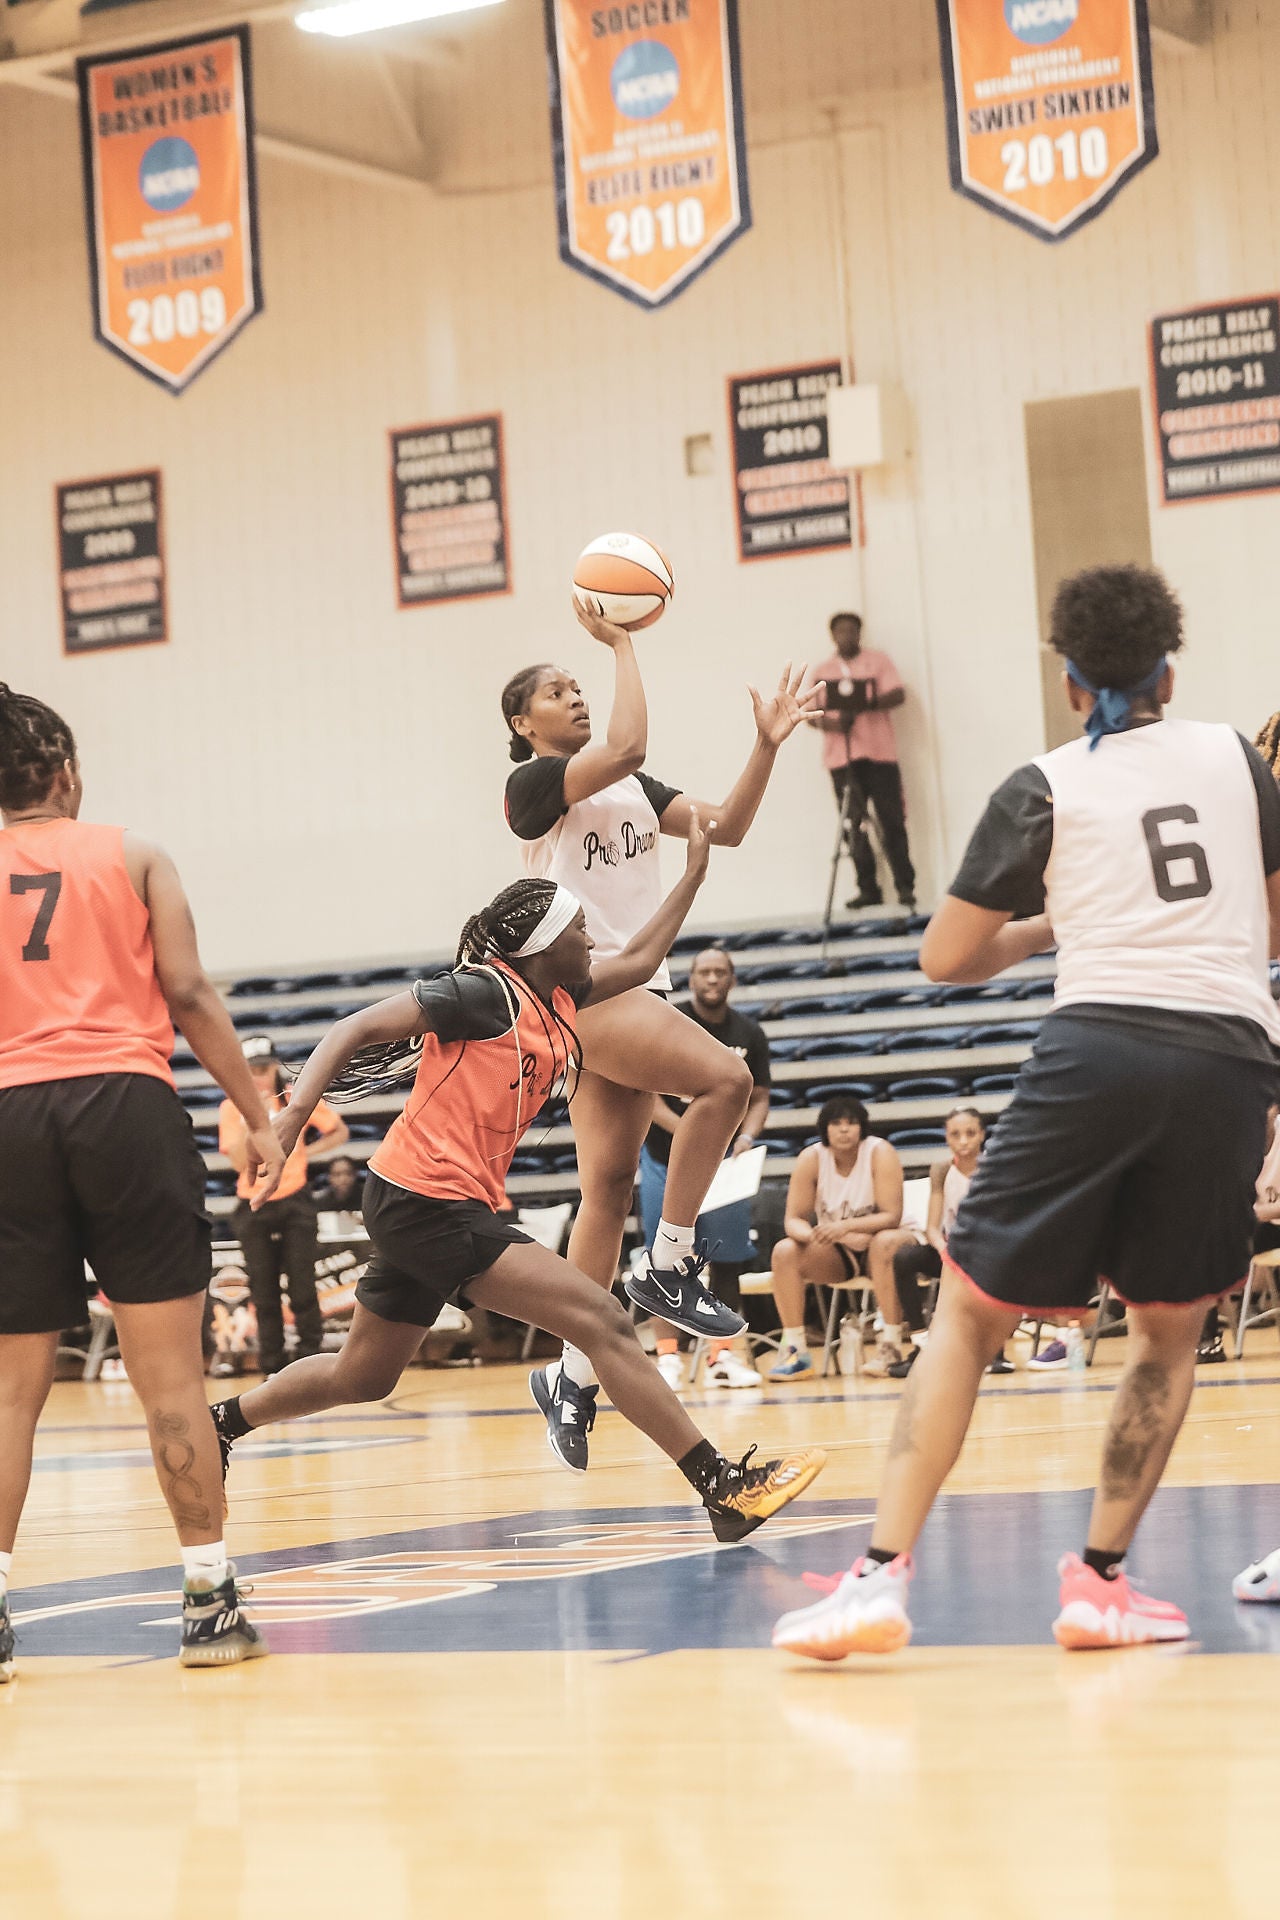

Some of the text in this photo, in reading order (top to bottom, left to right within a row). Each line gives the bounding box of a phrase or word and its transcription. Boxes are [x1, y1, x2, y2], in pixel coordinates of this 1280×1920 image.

[591, 0, 690, 38] SOCCER
[1011, 0, 1079, 32] NCAA
[113, 55, 217, 100] WOMEN'S
[617, 69, 679, 104] NCAA
[99, 86, 231, 138] BASKETBALL
[968, 81, 1130, 135] SWEET SIXTEEN
[587, 157, 715, 205] ELITE EIGHT
[1000, 126, 1108, 192] 2010
[606, 196, 705, 261] 2010
[126, 285, 226, 346] 2009
[1161, 307, 1271, 345] PEACH BELT
[1160, 329, 1276, 368] CONFERENCE
[1176, 360, 1265, 399] 2010-11
[762, 424, 822, 458] 2010
[1142, 804, 1212, 902] 6
[9, 871, 62, 961] 7
